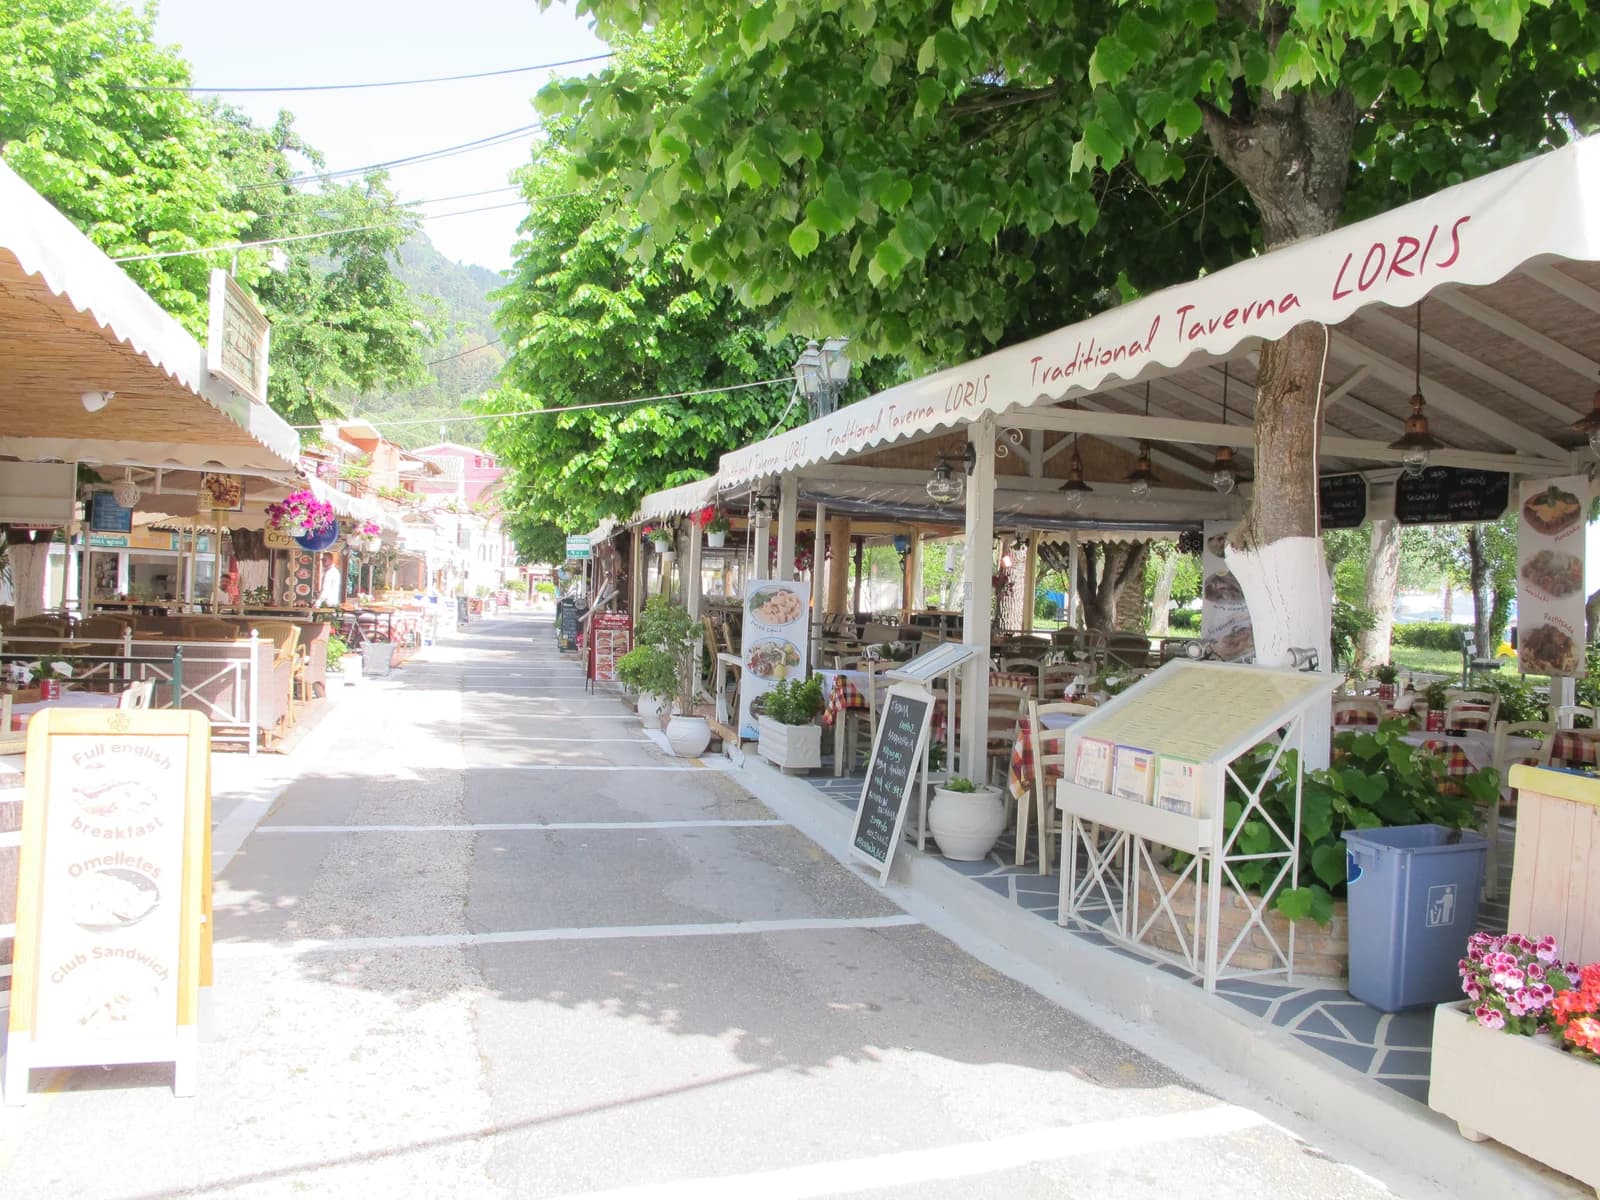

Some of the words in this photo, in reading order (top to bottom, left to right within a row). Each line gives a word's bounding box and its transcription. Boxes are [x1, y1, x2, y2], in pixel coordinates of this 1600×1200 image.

[1031, 314, 1161, 388] Traditional
[1178, 289, 1301, 346] Taverna
[1332, 214, 1471, 302] LORIS
[824, 407, 883, 449] Traditional
[888, 405, 934, 429] Taverna
[944, 374, 990, 415] LORIS
[784, 436, 808, 463] LORIS
[71, 743, 105, 767] Full
[110, 743, 172, 770] english
[70, 815, 164, 840] breakfast
[67, 850, 162, 879] Omelletes
[50, 953, 88, 985] Club
[91, 946, 169, 982] Sandwich
